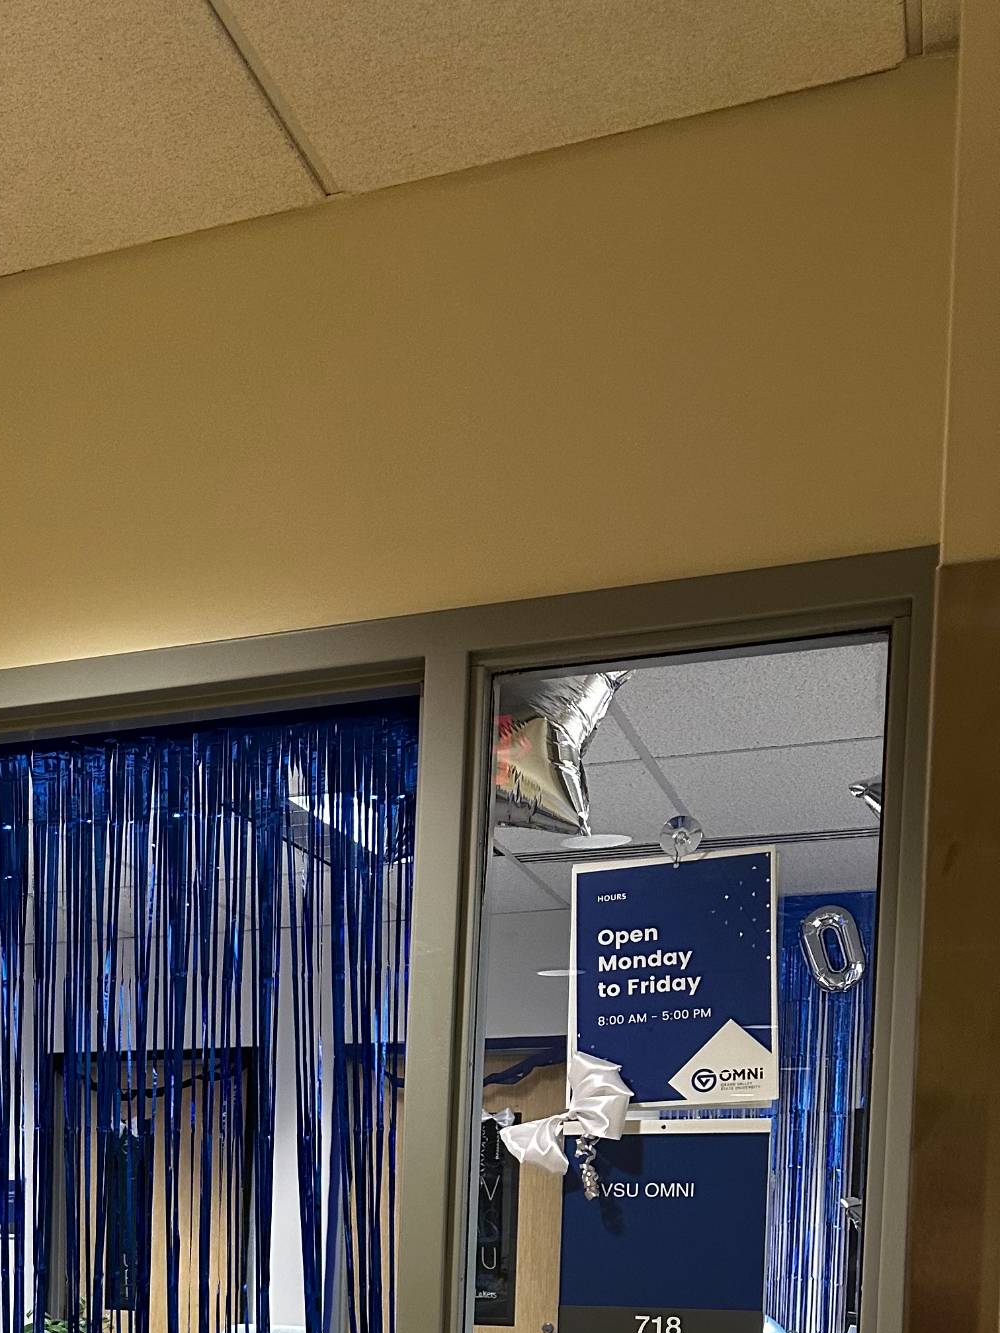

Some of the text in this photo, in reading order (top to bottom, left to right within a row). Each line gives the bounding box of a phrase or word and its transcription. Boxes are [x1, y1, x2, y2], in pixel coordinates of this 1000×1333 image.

[597, 893, 627, 903] HOURS
[597, 927, 658, 949] Open
[598, 950, 693, 972] Monday
[597, 975, 702, 998] to Friday
[597, 1014, 625, 1027] 8:00
[628, 1013, 648, 1025] AM
[662, 1010, 690, 1022] 5:00
[693, 1008, 713, 1020] PM
[644, 1182, 695, 1198] OMNI
